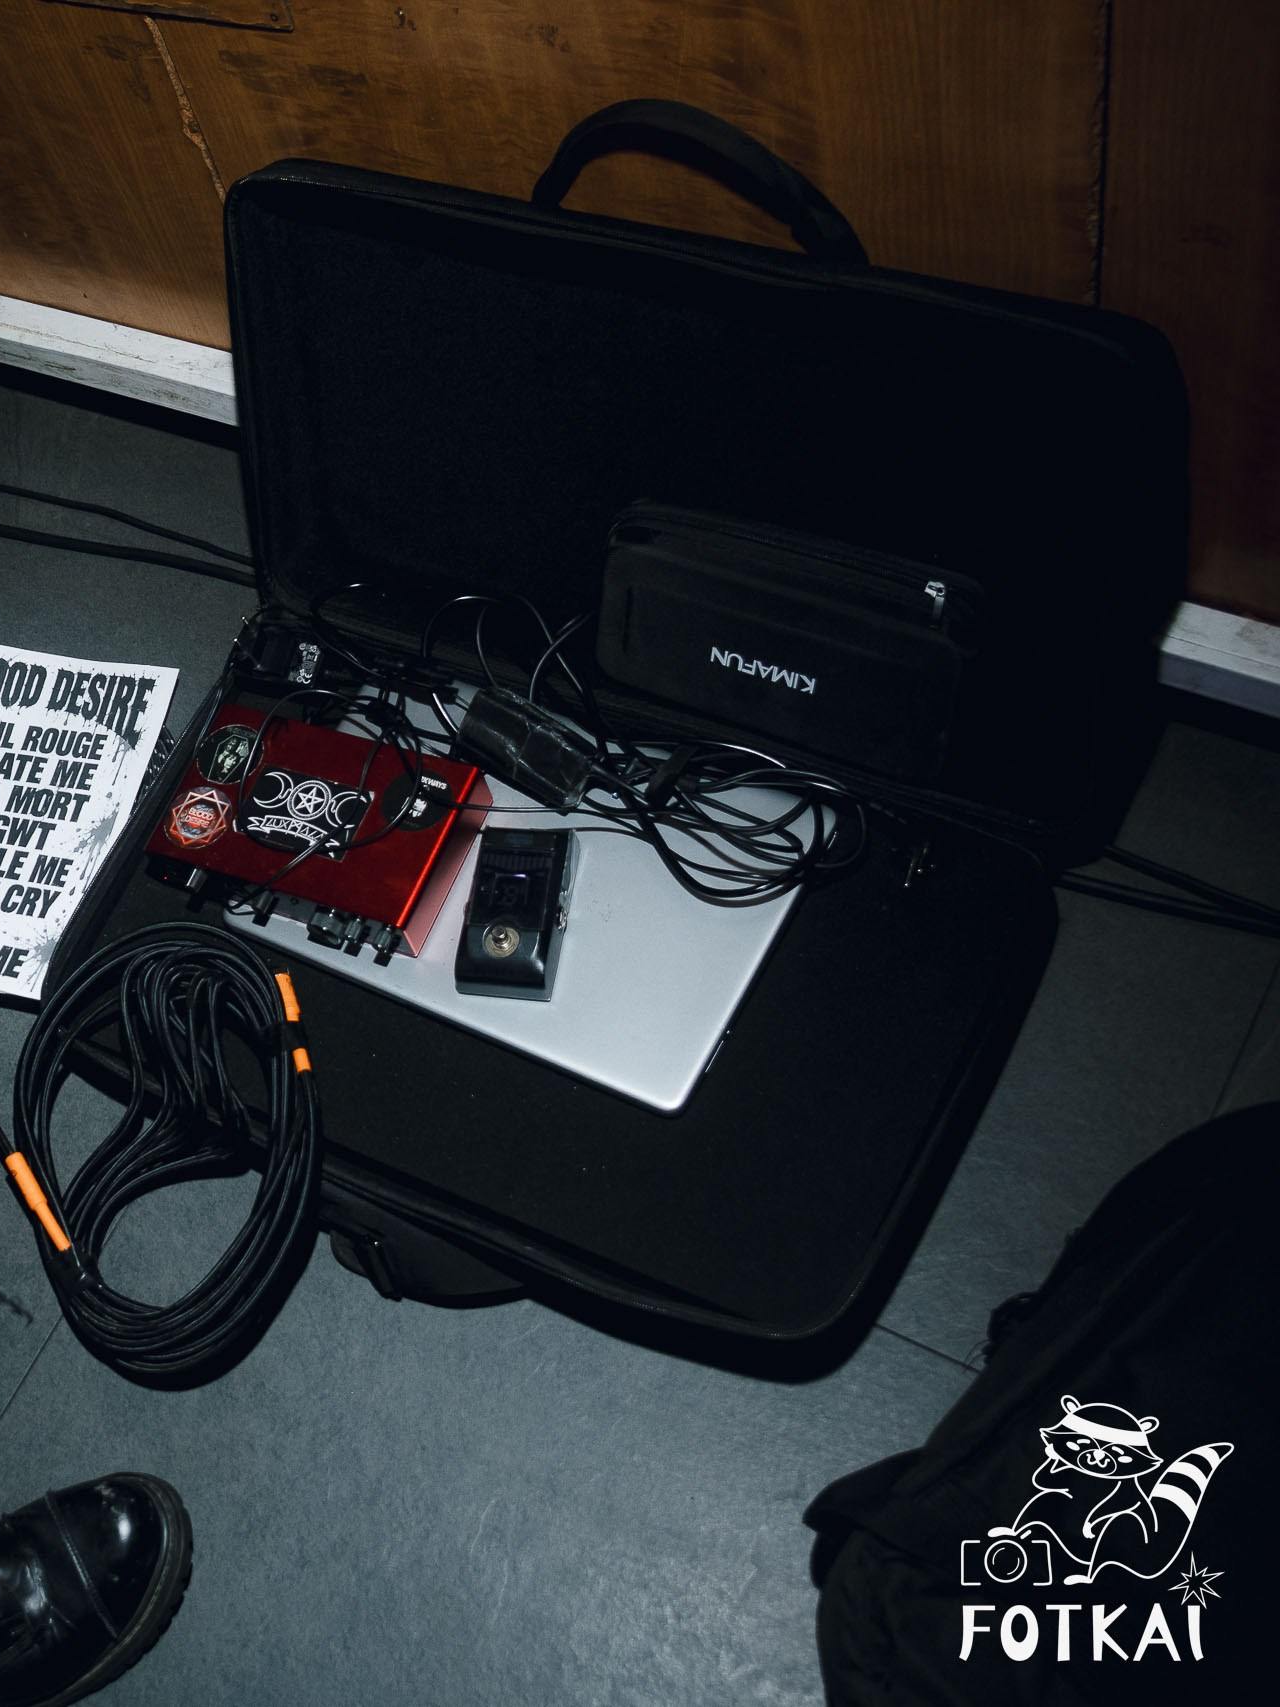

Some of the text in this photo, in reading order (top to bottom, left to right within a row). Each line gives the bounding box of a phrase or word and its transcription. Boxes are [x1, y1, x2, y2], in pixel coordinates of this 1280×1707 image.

[710, 646, 816, 694] KIMAFUN
[46, 668, 156, 749] DESIRE
[21, 726, 108, 760] ROUGE
[50, 761, 97, 790] ME
[5, 785, 90, 822] MORT
[188, 807, 213, 820] BLOOD
[29, 855, 73, 887] ME
[1, 885, 61, 918] CRY
